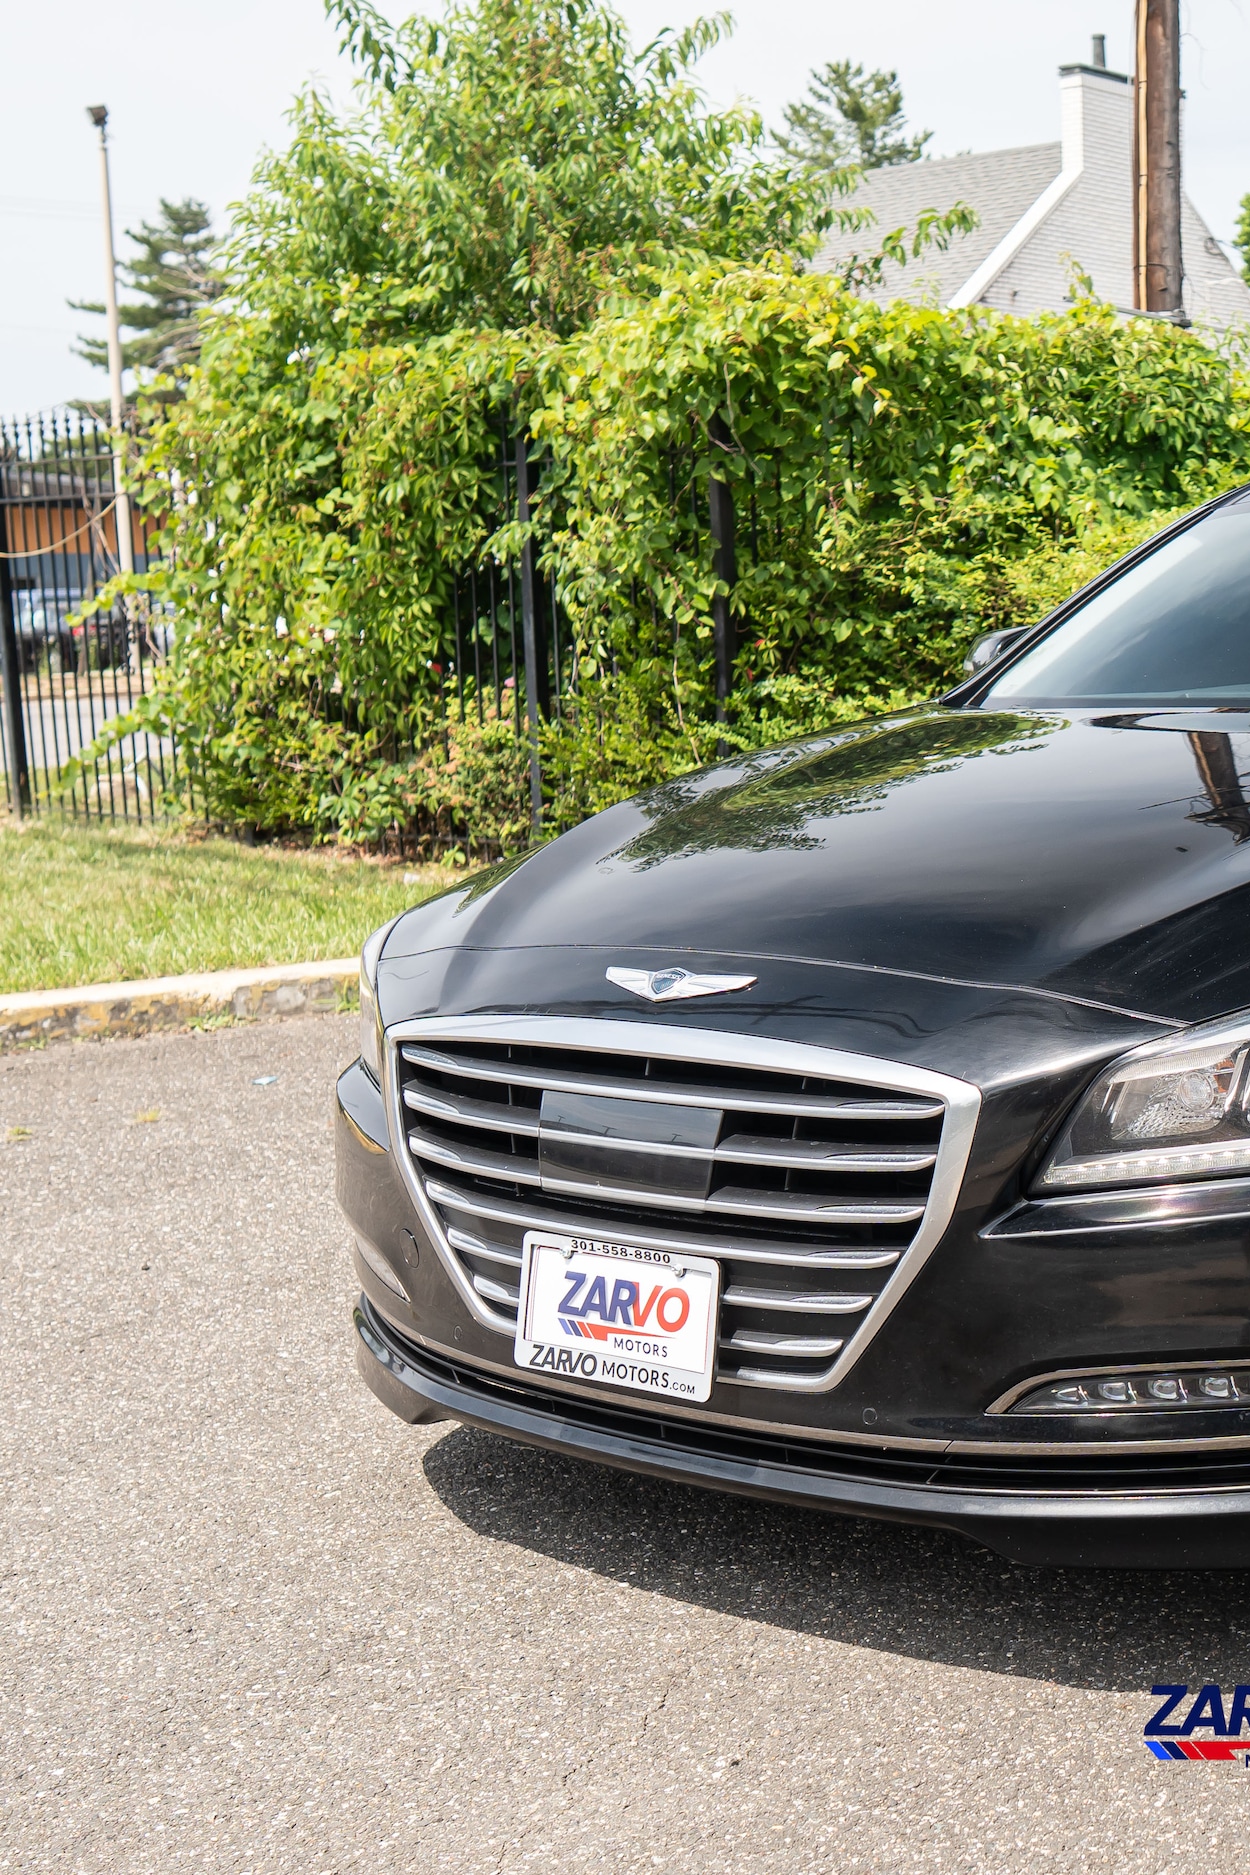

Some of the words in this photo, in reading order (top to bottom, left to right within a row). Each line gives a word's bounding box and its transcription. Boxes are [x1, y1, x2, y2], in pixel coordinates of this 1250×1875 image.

[570, 1239, 671, 1264] 301-558-8800
[558, 1270, 690, 1333] ZARVO
[529, 1344, 597, 1377] ZARVO
[613, 1337, 668, 1358] MOTORS
